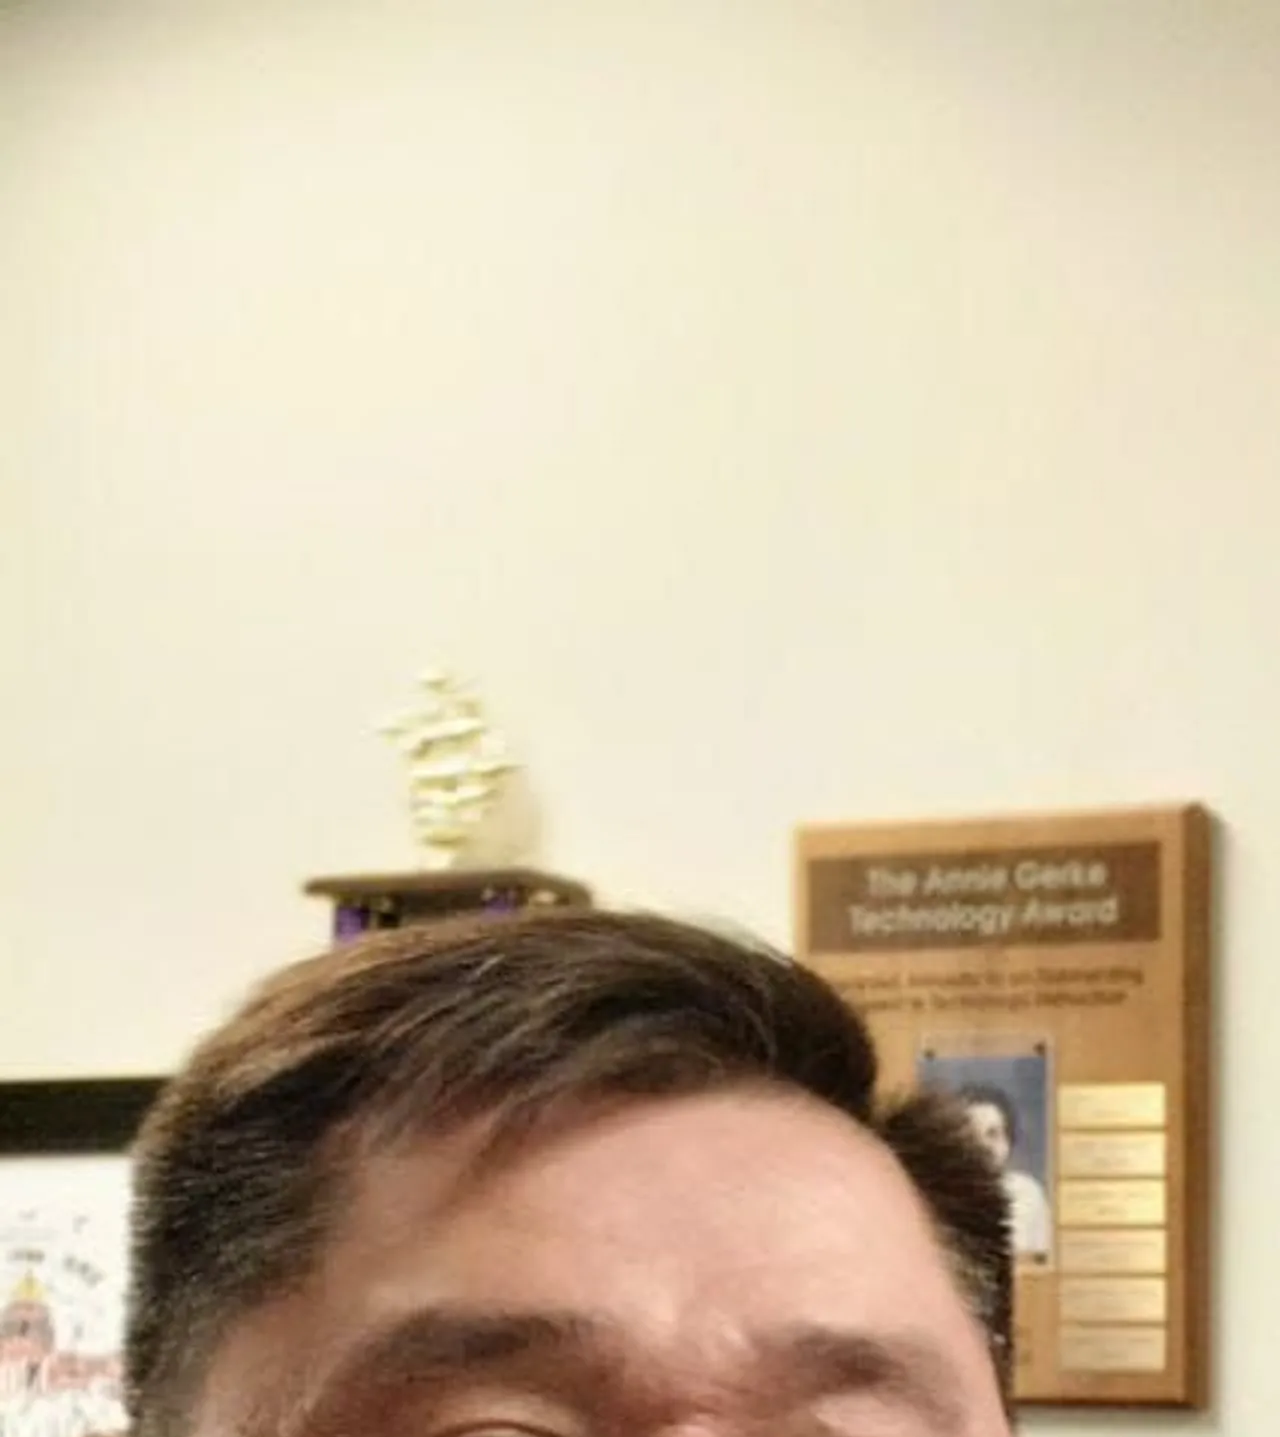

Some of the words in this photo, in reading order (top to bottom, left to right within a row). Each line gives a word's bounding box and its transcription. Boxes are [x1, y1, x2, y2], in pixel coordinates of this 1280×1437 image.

[866, 868, 918, 896] The
[923, 863, 1008, 895] Annie
[849, 901, 1015, 936] Technology
[1021, 897, 1119, 926] Award
